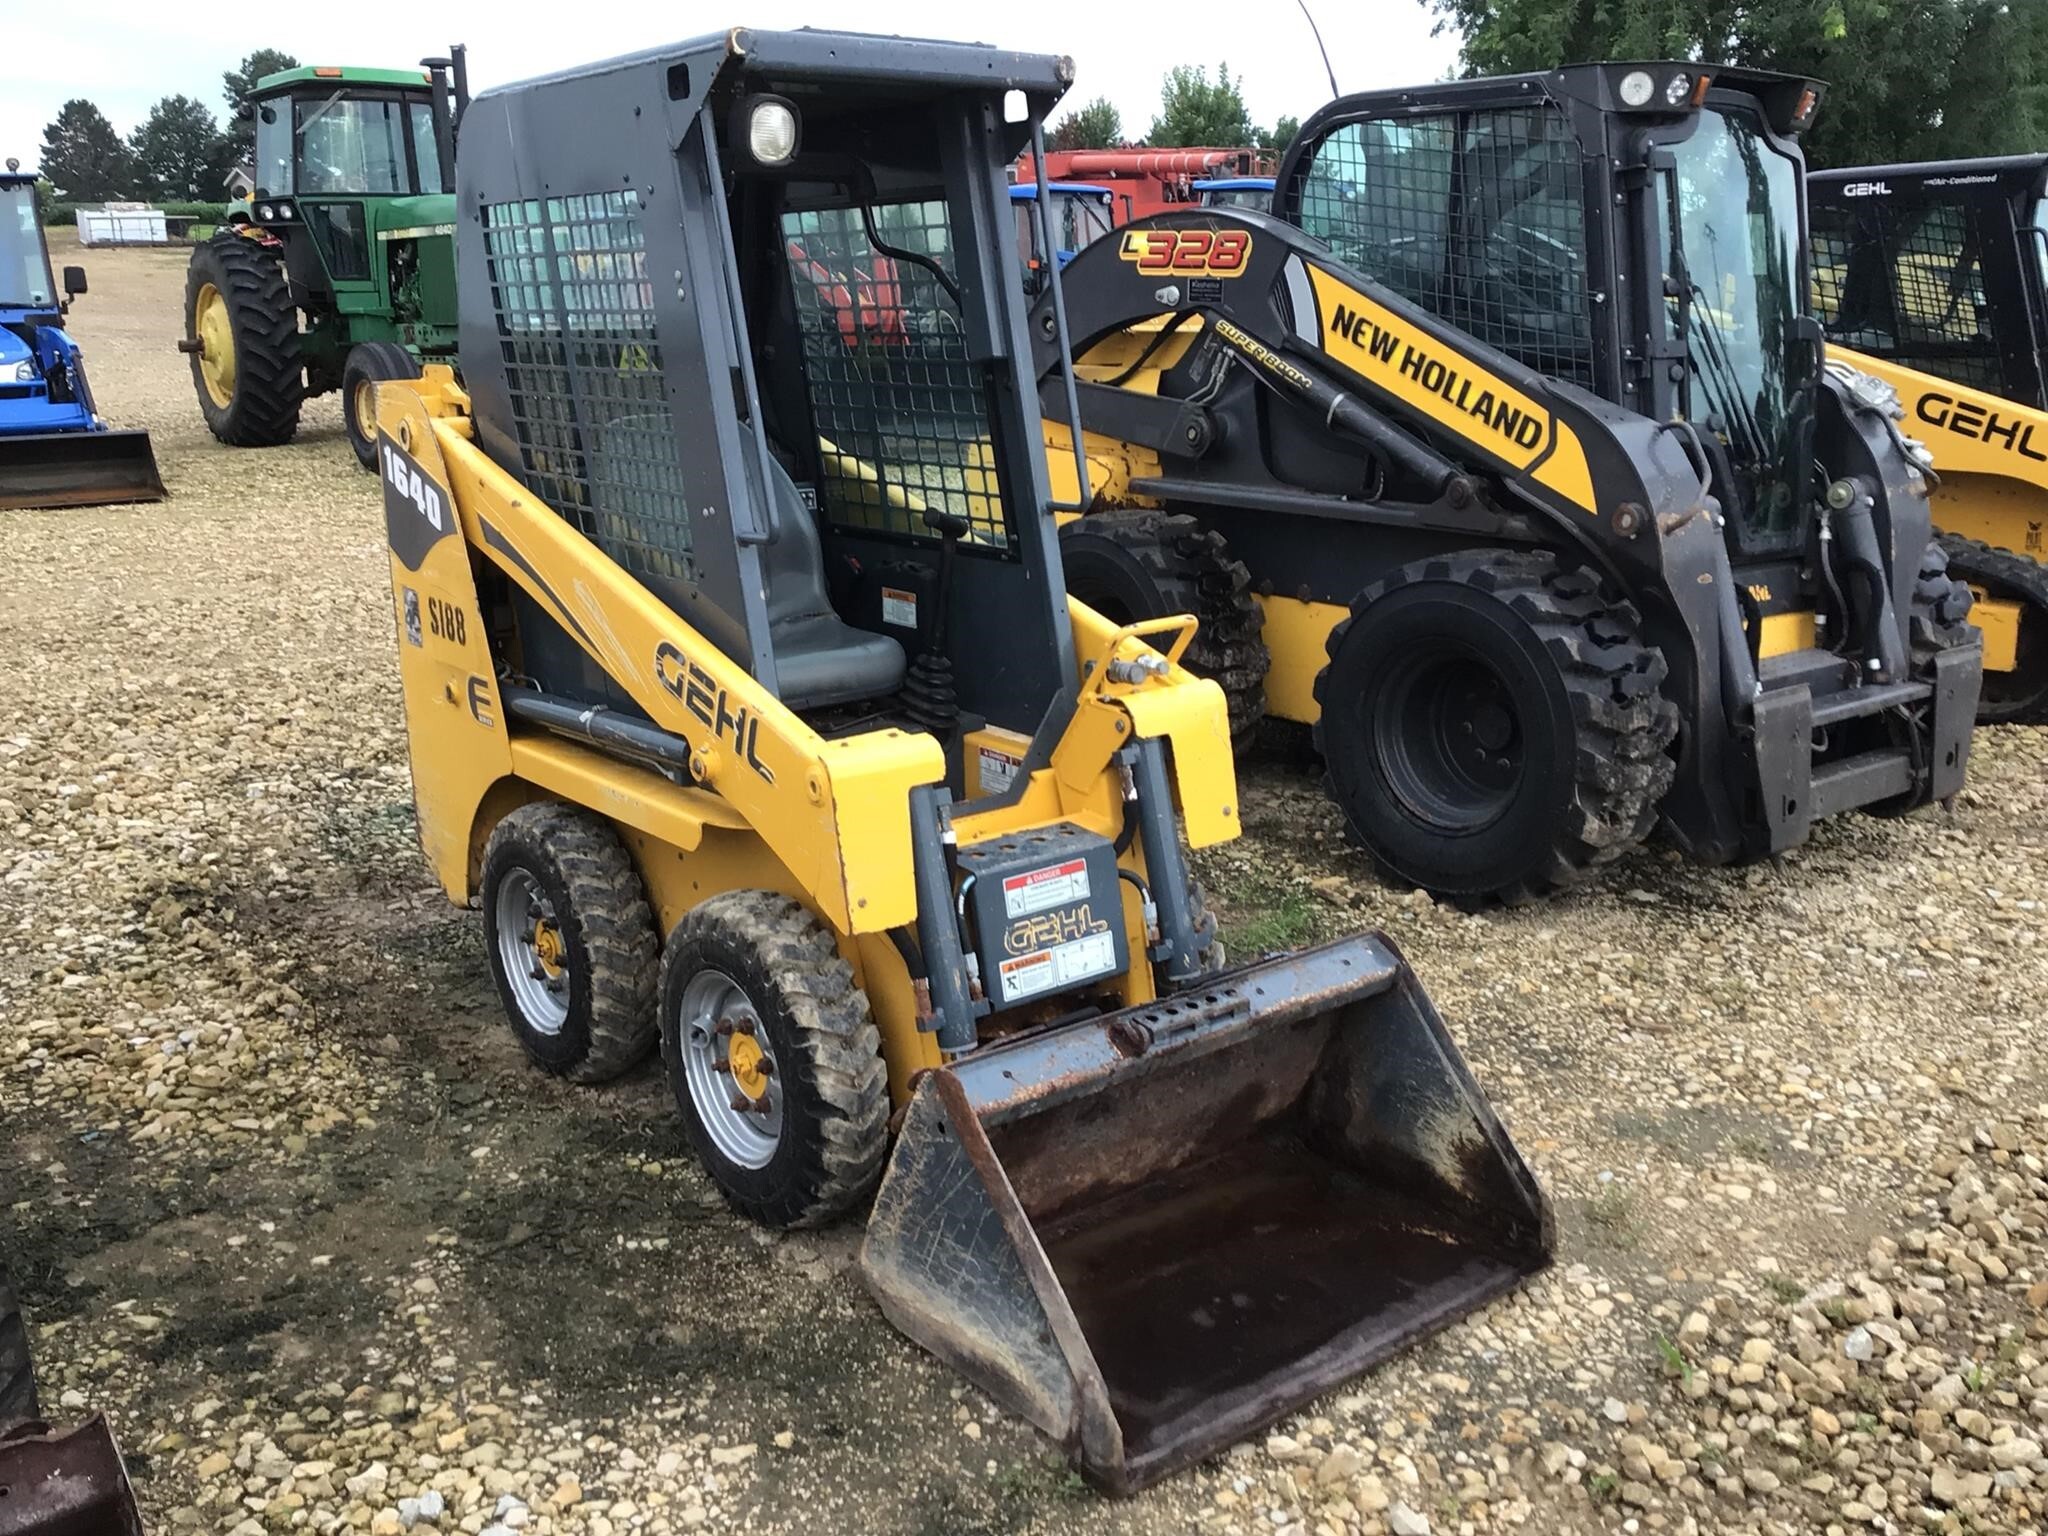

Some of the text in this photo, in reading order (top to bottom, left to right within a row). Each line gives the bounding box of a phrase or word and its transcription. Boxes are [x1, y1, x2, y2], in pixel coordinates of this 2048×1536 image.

[1843, 182, 1893, 197] GEHL
[1119, 230, 1252, 277] L328
[1331, 303, 1543, 450] NEW HOLLAND
[1915, 392, 2047, 462] GEHL
[383, 445, 443, 532] 1640
[655, 639, 776, 786] GEHL
[1032, 868, 1061, 884] DANGER
